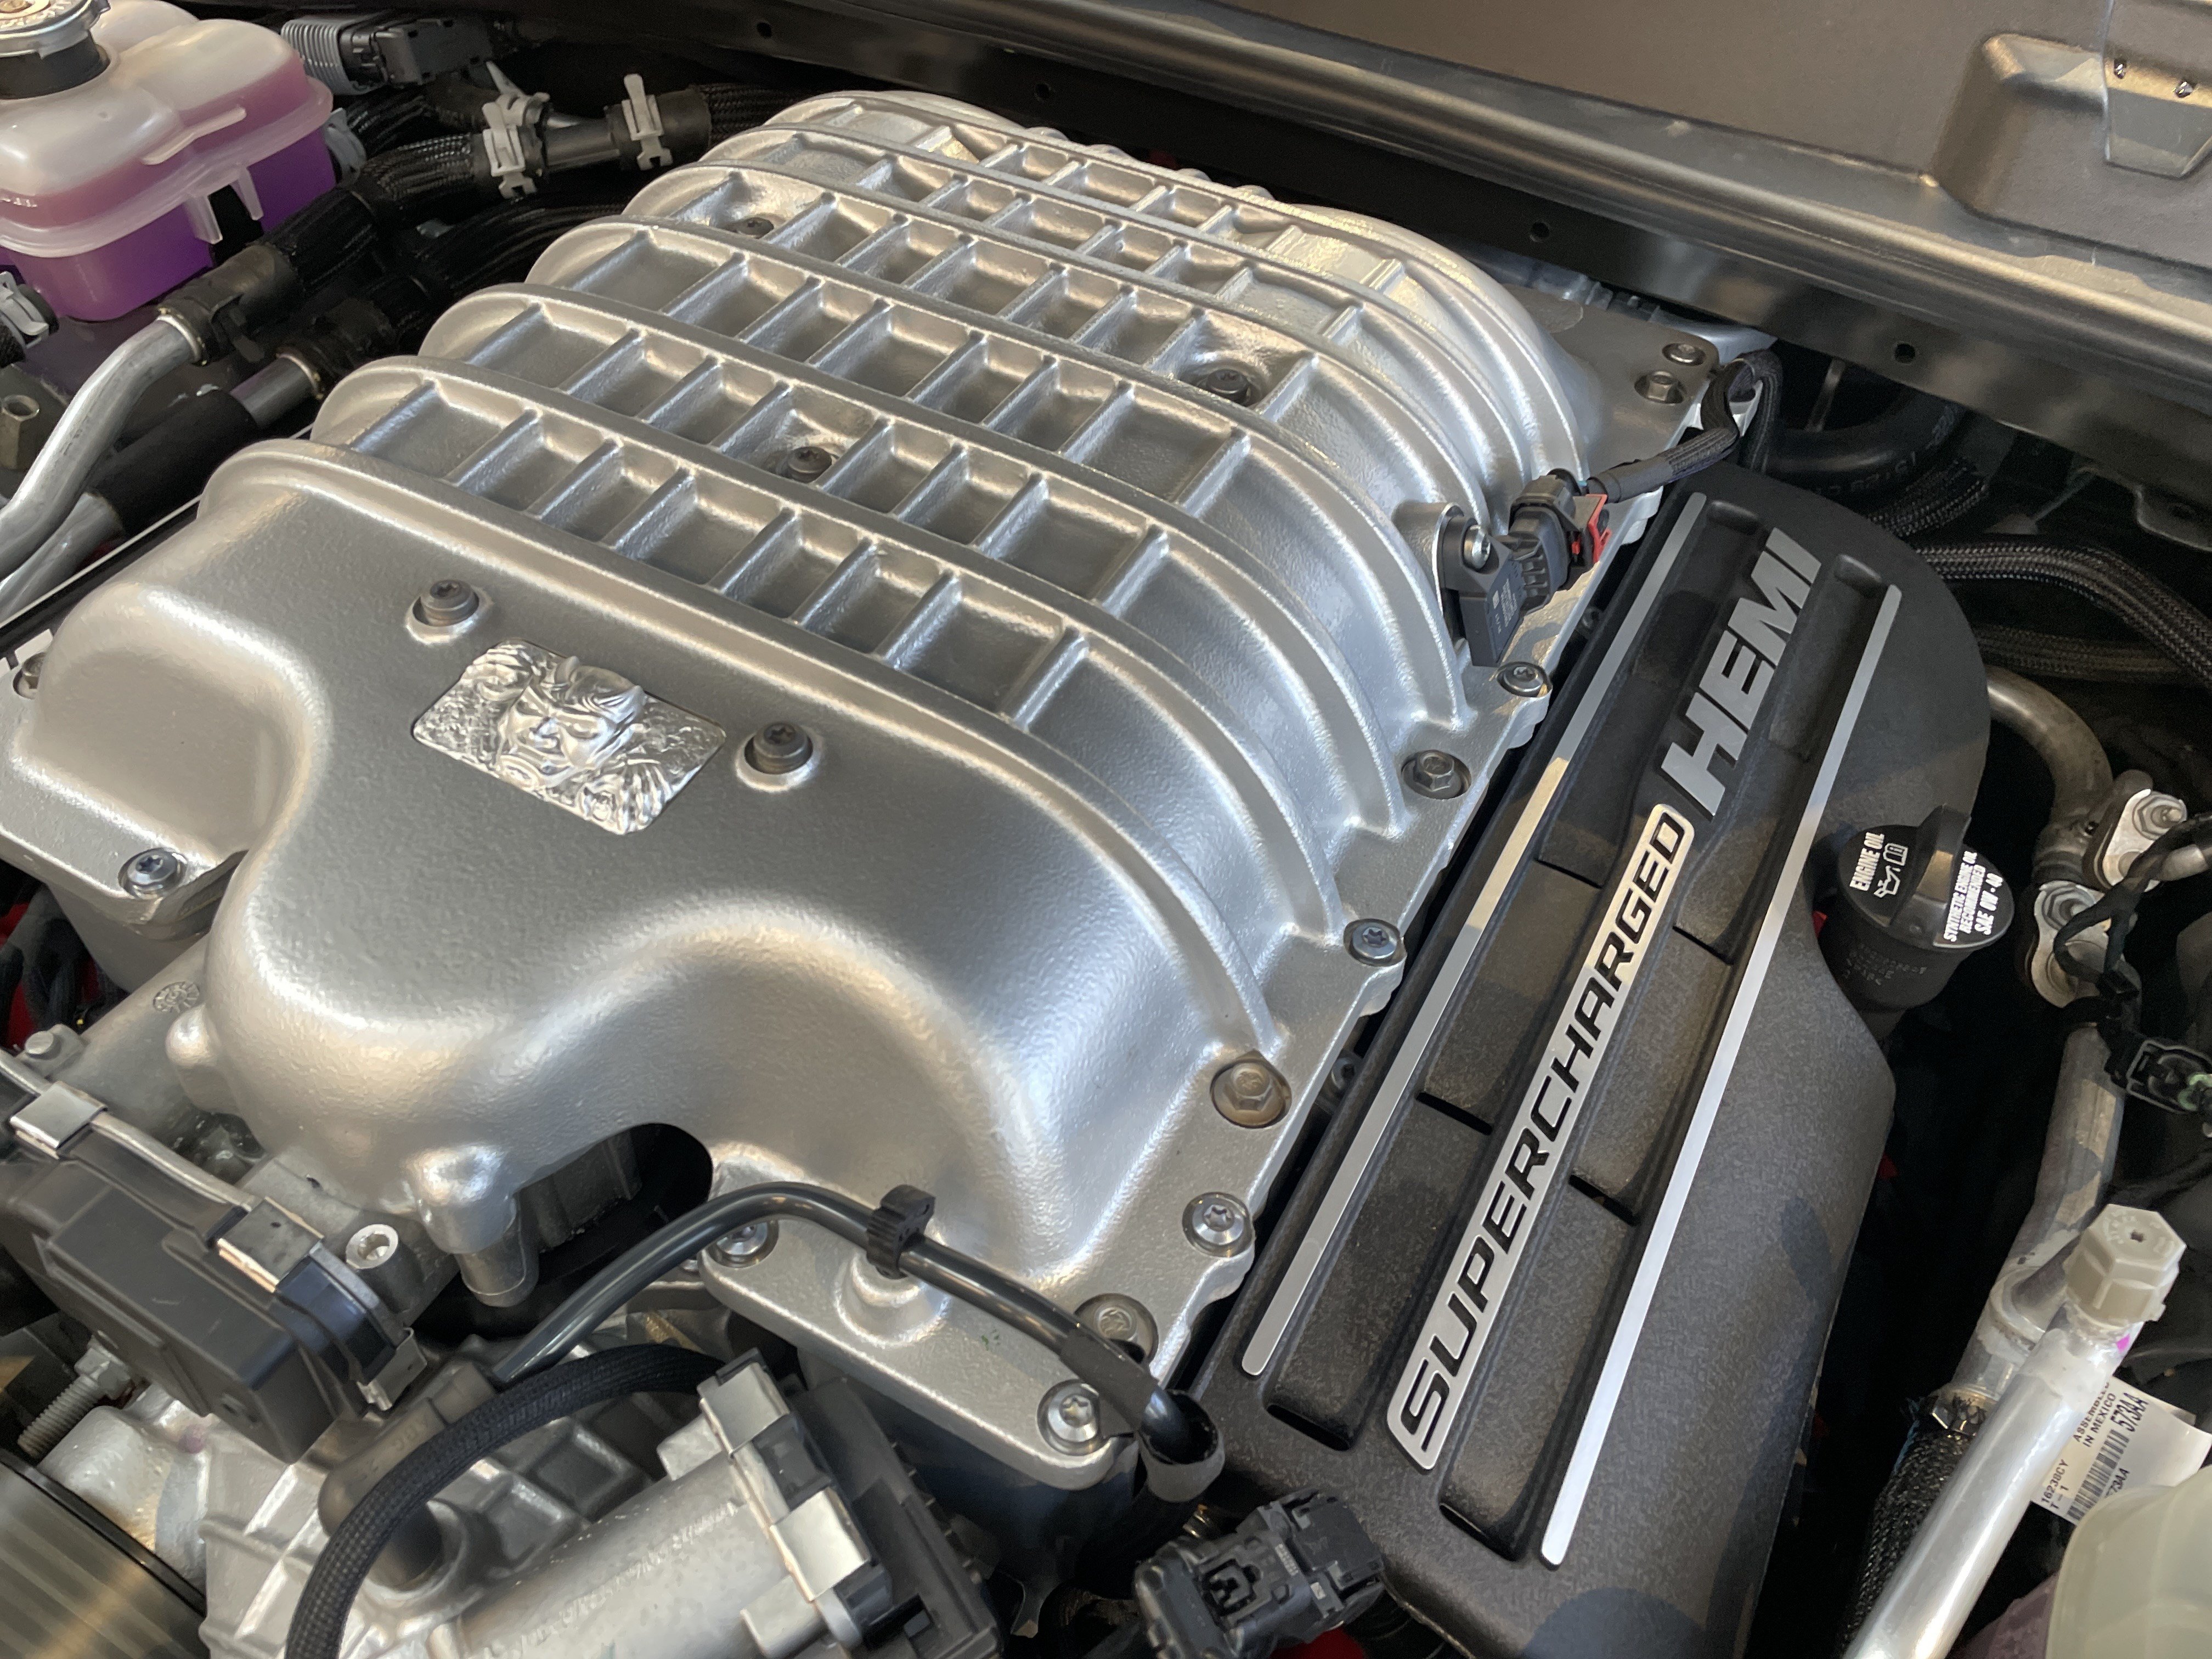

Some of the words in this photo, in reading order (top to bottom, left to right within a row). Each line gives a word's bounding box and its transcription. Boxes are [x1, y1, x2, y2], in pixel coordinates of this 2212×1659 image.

[1864, 832, 1885, 850] OIL
[1962, 850, 1978, 864] OIL
[1849, 848, 1881, 891] ENGINE
[1954, 862, 1974, 894] ENGINE
[1943, 891, 1966, 942] SYNTHETIC
[1959, 864, 1986, 934] RECOMMENDED
[1974, 910, 1994, 935] SAE
[1400, 812, 1685, 1453] SUPERCHARGED
[1661, 527, 1821, 816] HEMI
[2083, 1435, 2095, 1448] IN
[2091, 1393, 2116, 1434] MEXICO
[2111, 1392, 2149, 1432] 573AA
